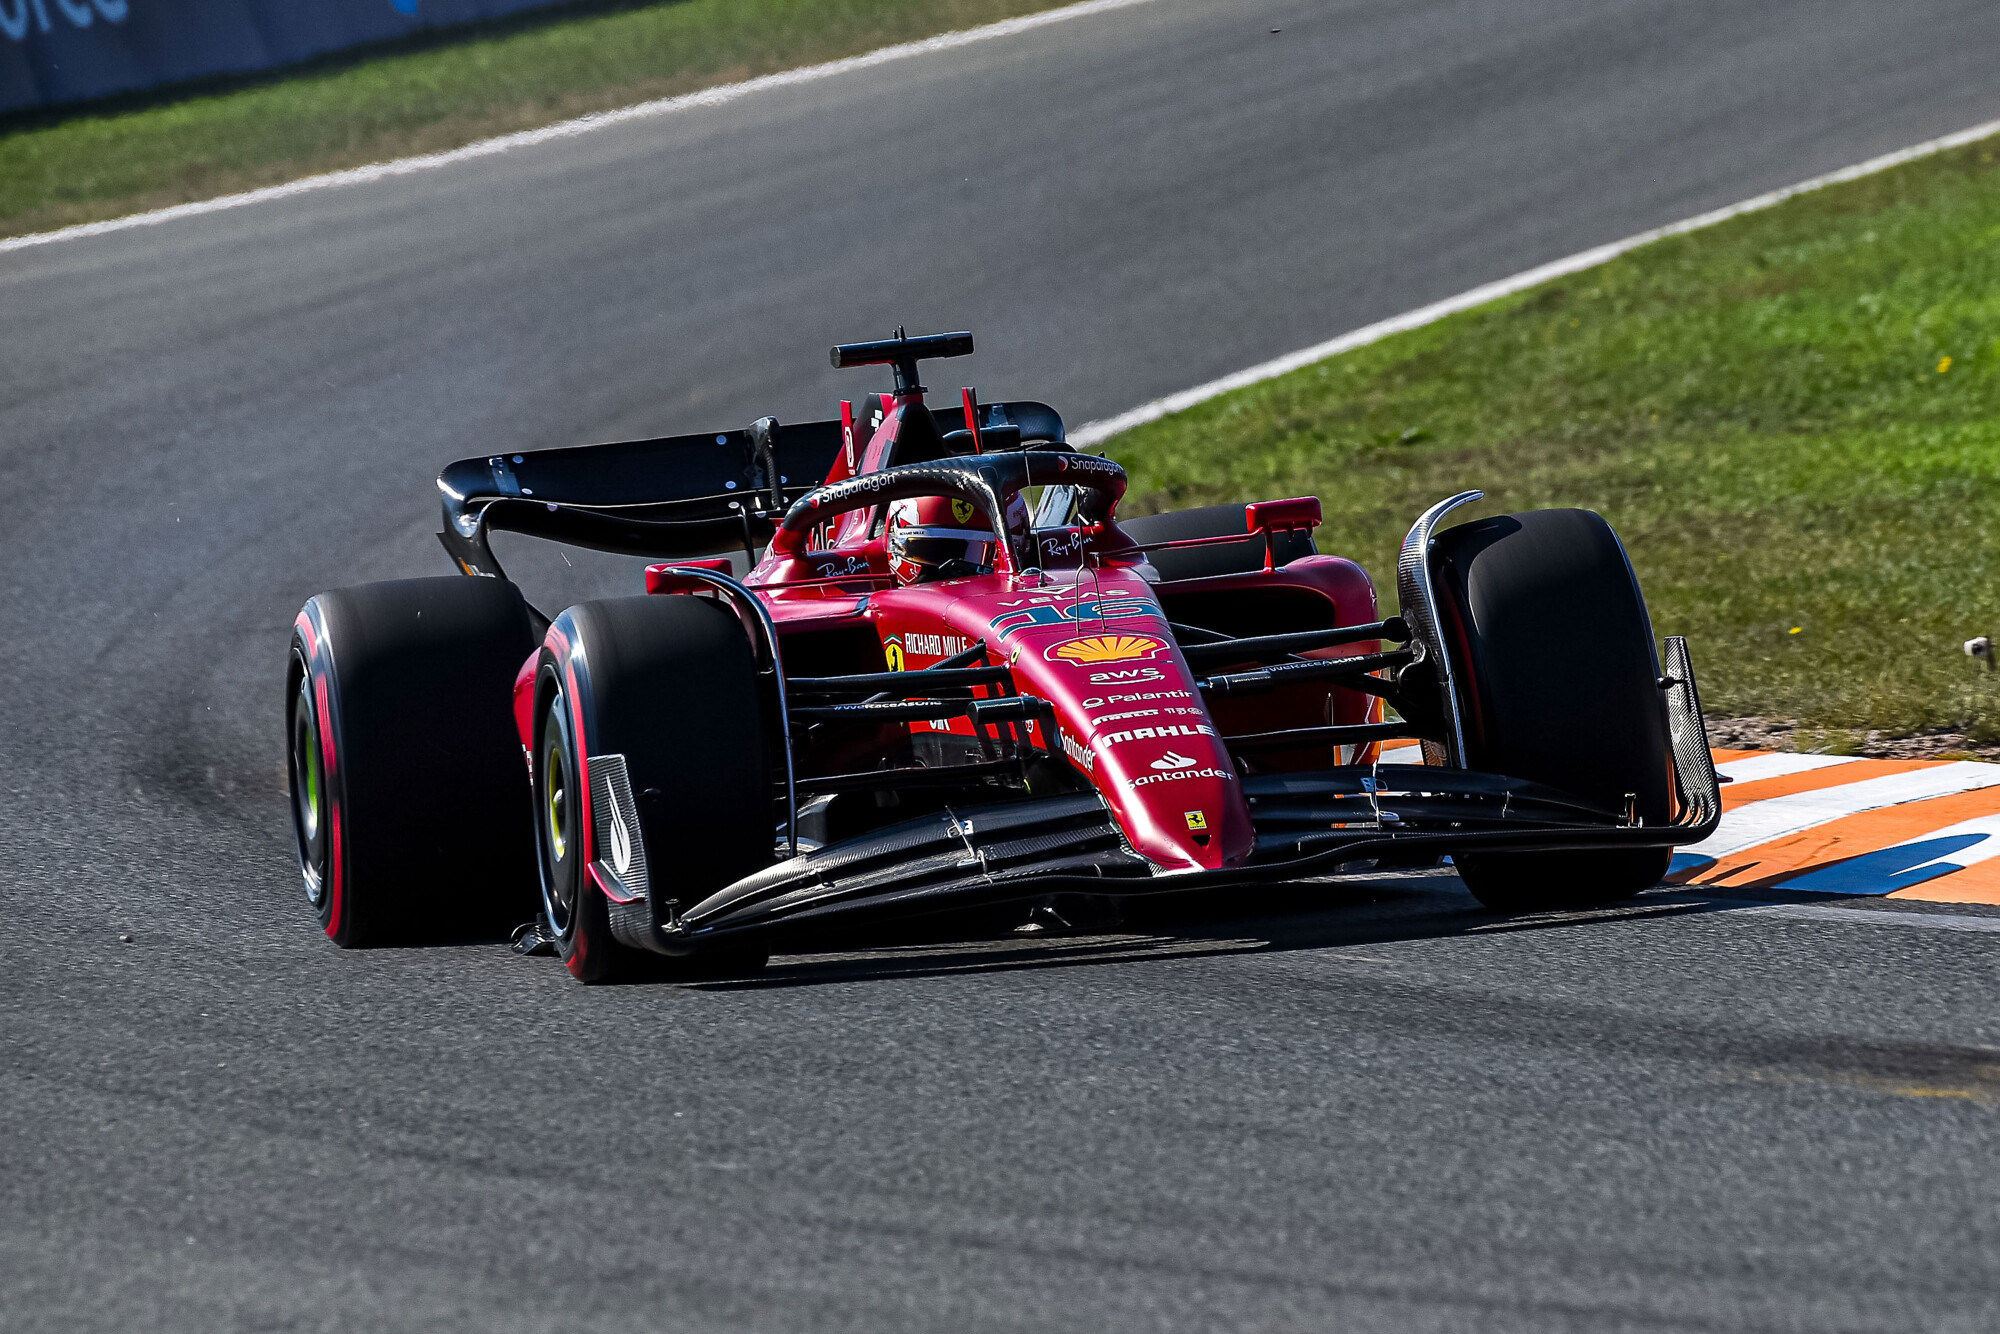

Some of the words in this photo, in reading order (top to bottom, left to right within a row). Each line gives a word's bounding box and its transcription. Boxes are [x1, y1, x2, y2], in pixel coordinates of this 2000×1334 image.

[1071, 456, 1123, 475] Snapdragon
[822, 474, 896, 503] Snapdragon
[817, 556, 869, 577] Ray-Ban
[988, 597, 1168, 643] 16
[905, 632, 941, 656] RICHARD
[1089, 667, 1162, 684] aws
[1107, 689, 1193, 704] Palantir
[1060, 726, 1097, 771] Santander
[1101, 724, 1215, 749] MAHLE
[1127, 767, 1234, 792] Santander
